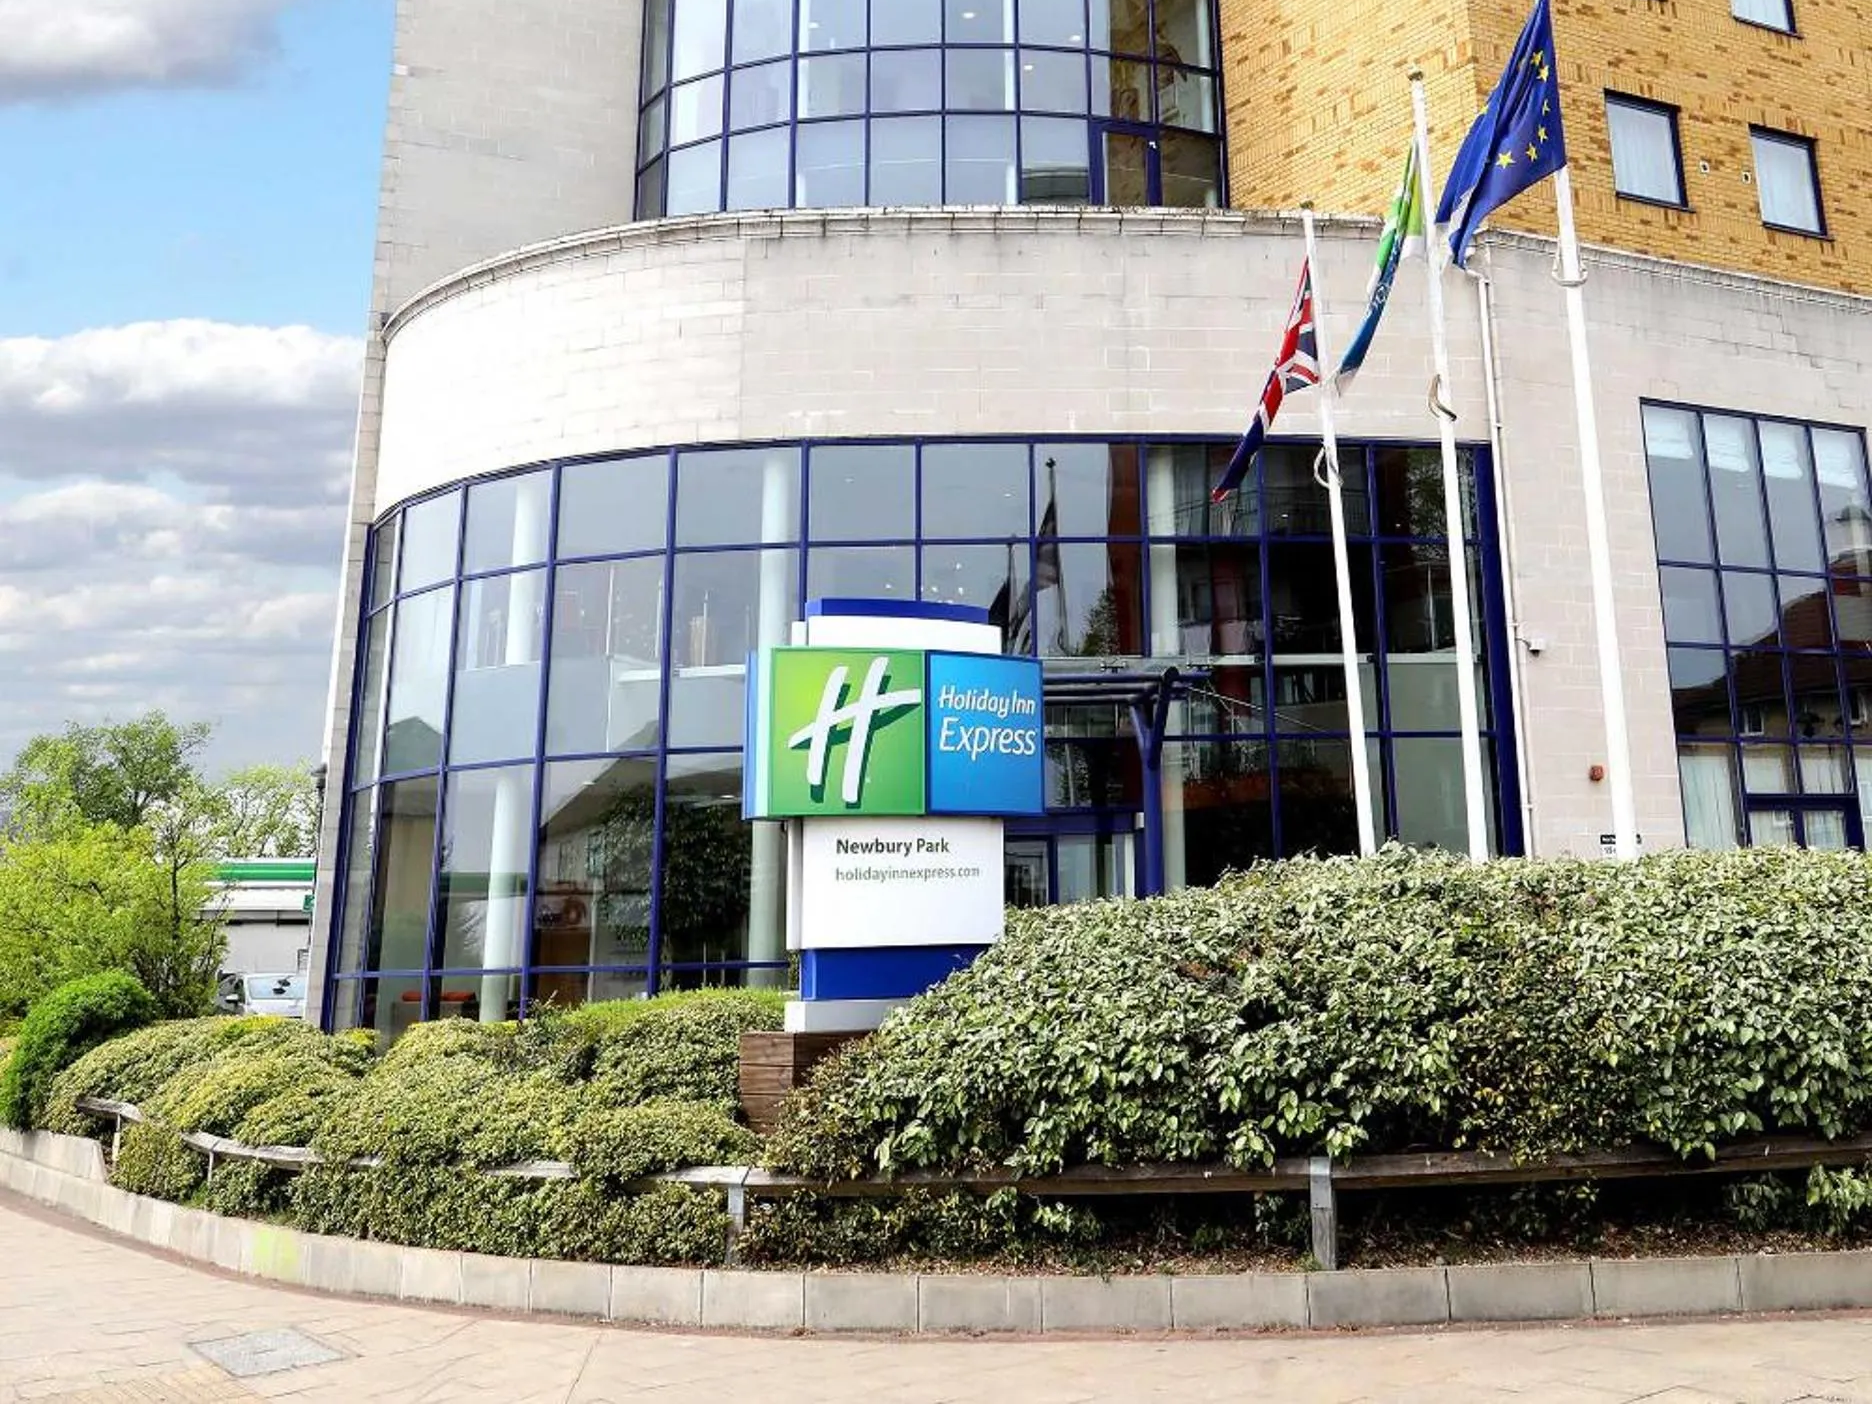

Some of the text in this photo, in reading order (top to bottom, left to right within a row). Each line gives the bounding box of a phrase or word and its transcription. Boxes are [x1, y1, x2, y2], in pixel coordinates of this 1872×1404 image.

[938, 684, 1036, 719] Holiday Inn
[939, 716, 1037, 761] Express
[836, 837, 950, 857] Newbury Park
[835, 866, 980, 883] holidayinnexpress.com
